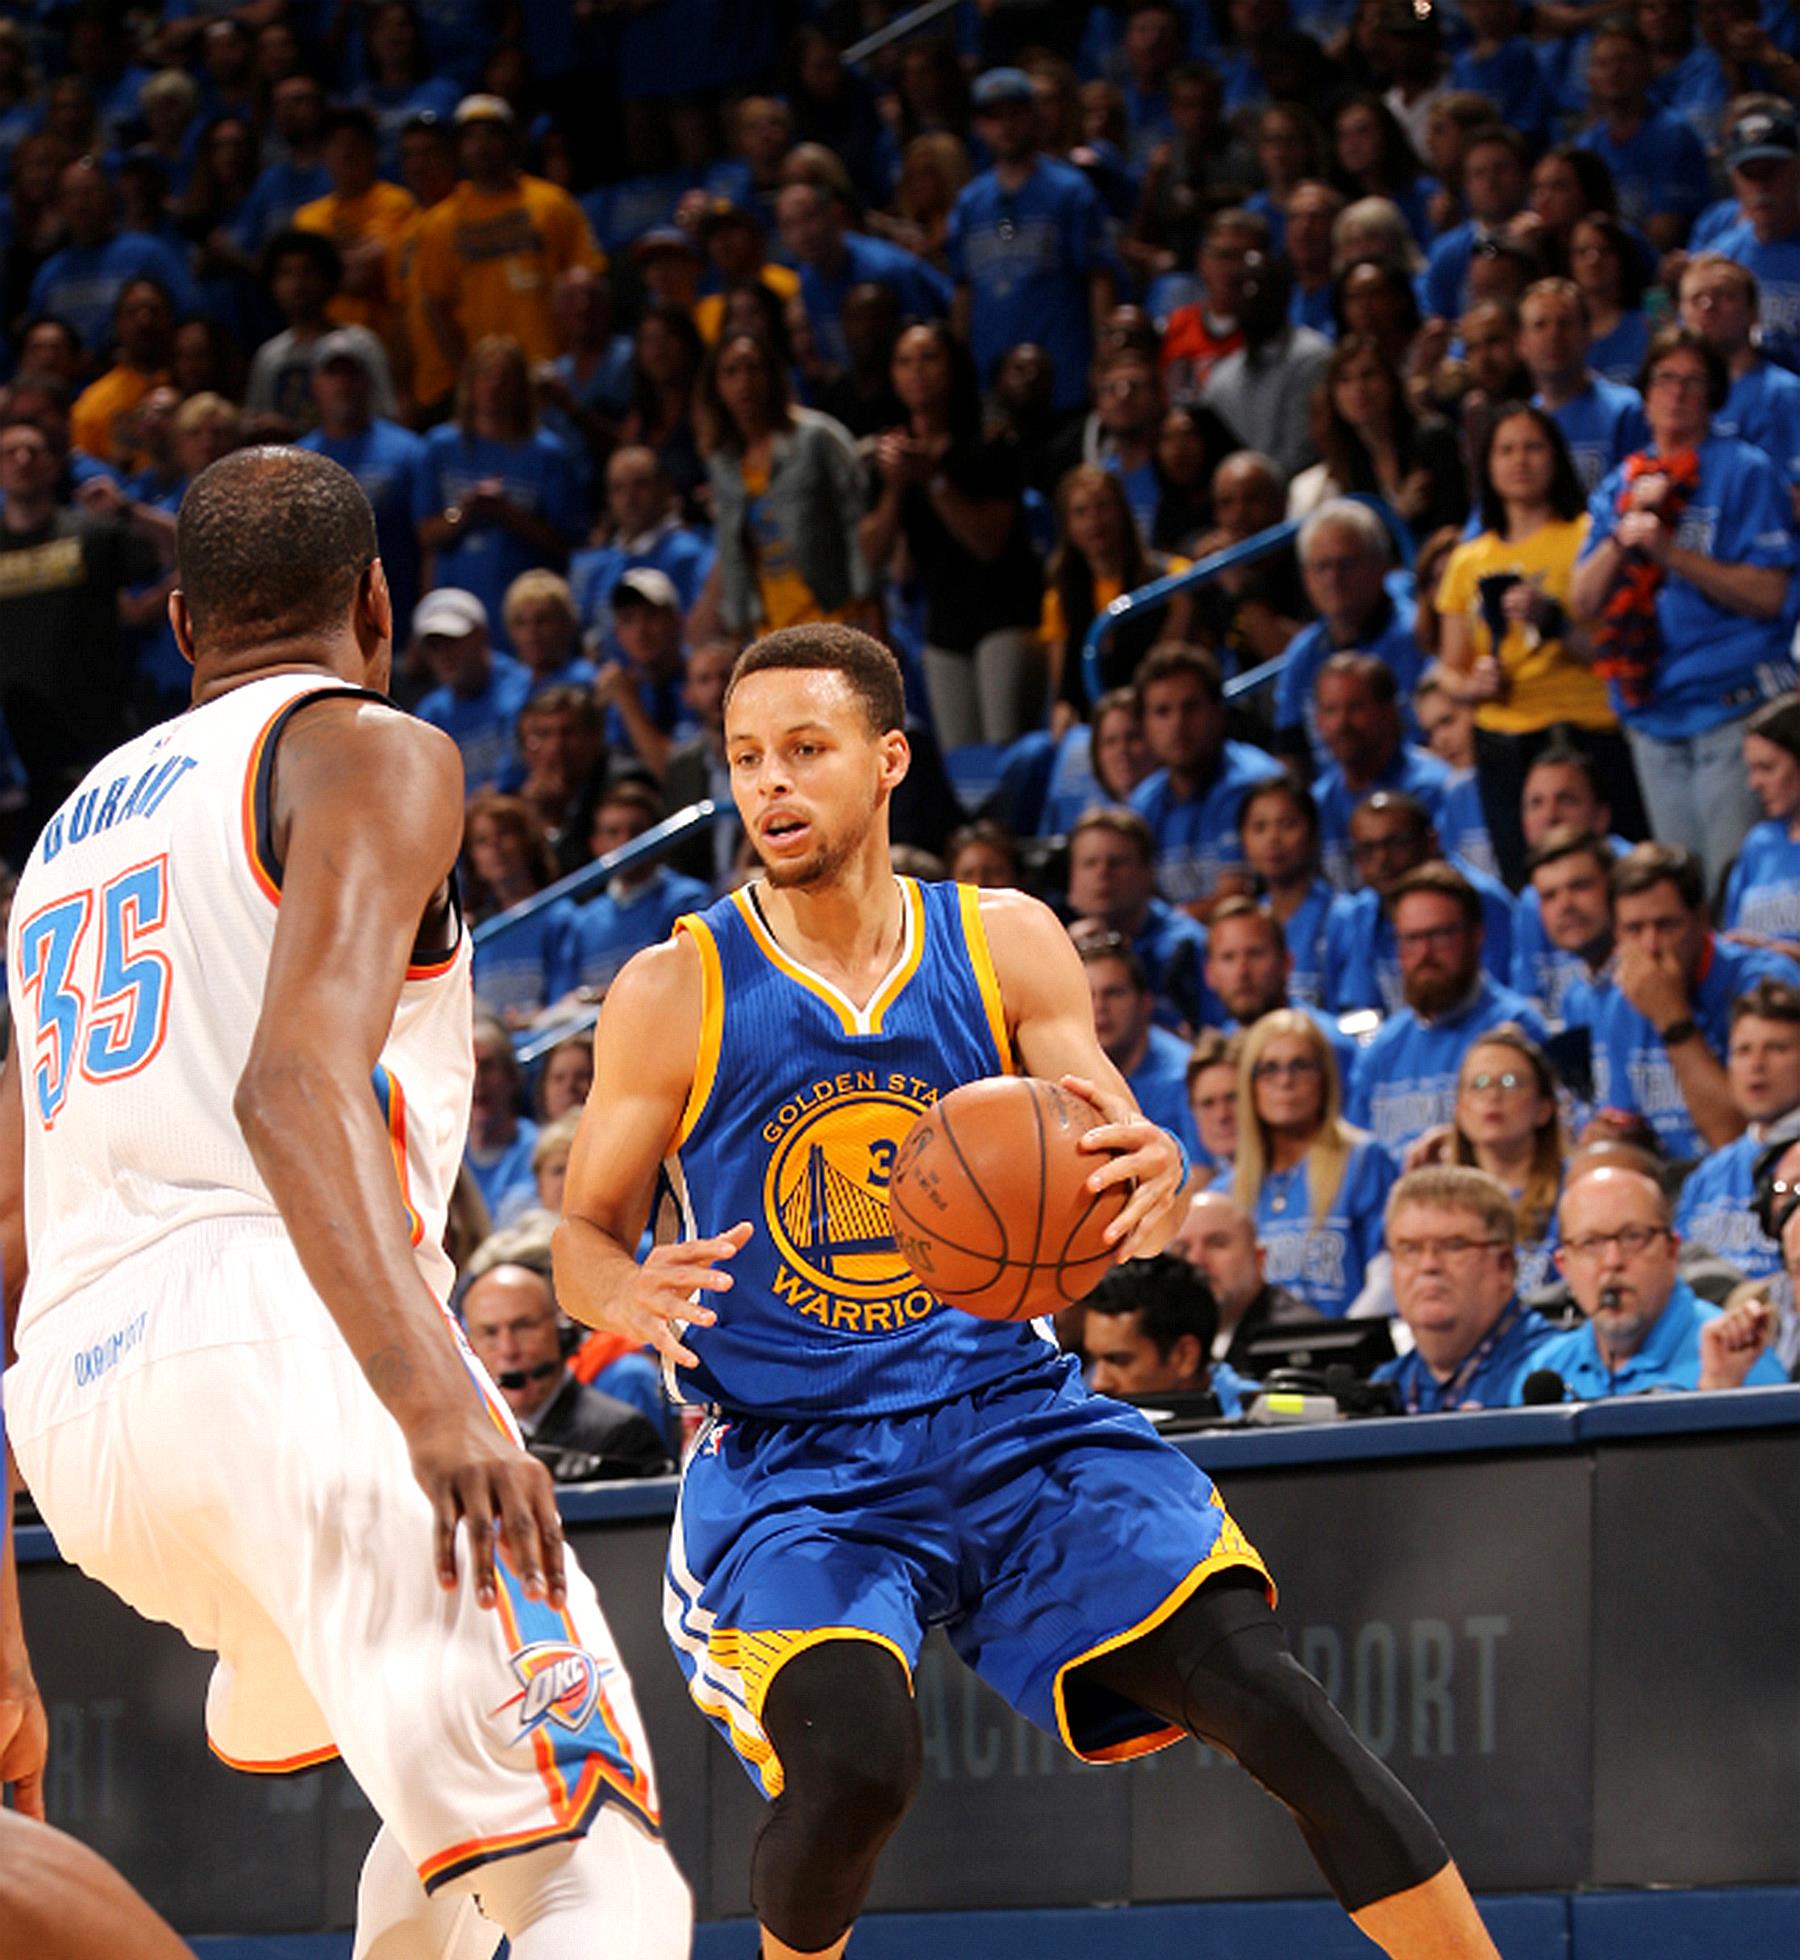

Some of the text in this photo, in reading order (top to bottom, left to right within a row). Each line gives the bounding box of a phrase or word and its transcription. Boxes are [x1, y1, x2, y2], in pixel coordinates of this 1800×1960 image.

[43, 755, 199, 865] DURANT
[17, 852, 173, 1131] 35
[762, 1071, 941, 1144] GOLDEN STA
[866, 1138, 900, 1188] 3
[771, 1262, 944, 1333] WARRIO
[520, 1653, 586, 1724] OKC
